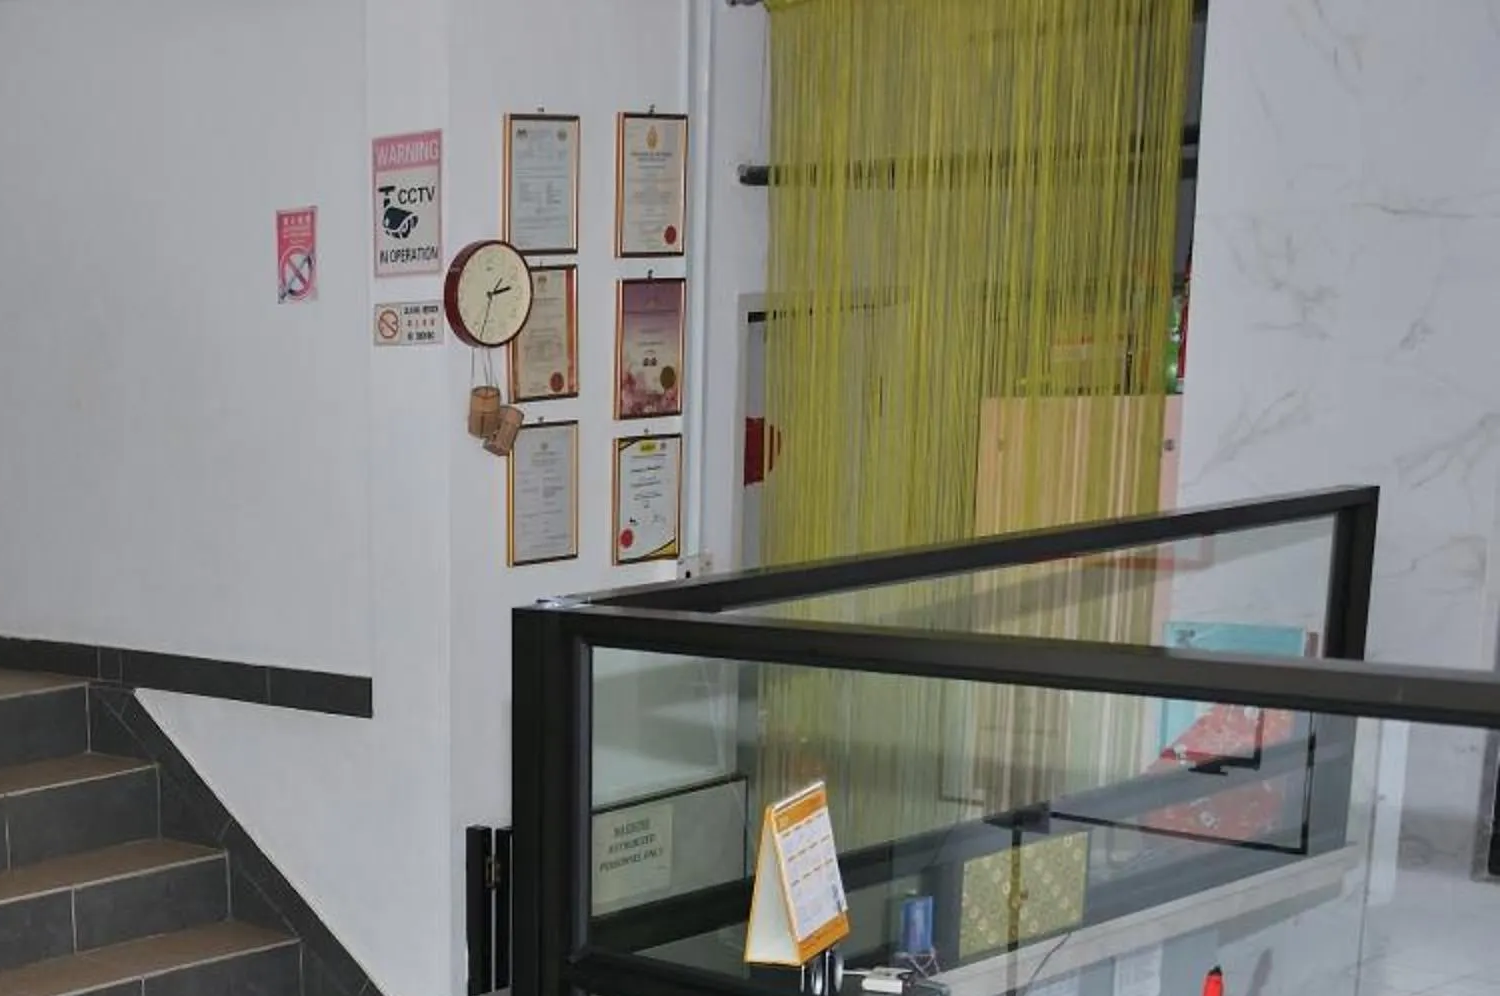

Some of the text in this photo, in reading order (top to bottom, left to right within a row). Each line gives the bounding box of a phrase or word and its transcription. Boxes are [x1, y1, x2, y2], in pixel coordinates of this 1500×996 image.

[377, 139, 438, 166] WARNING
[397, 186, 436, 205] CCTV
[379, 246, 439, 265] IN OPERATION
